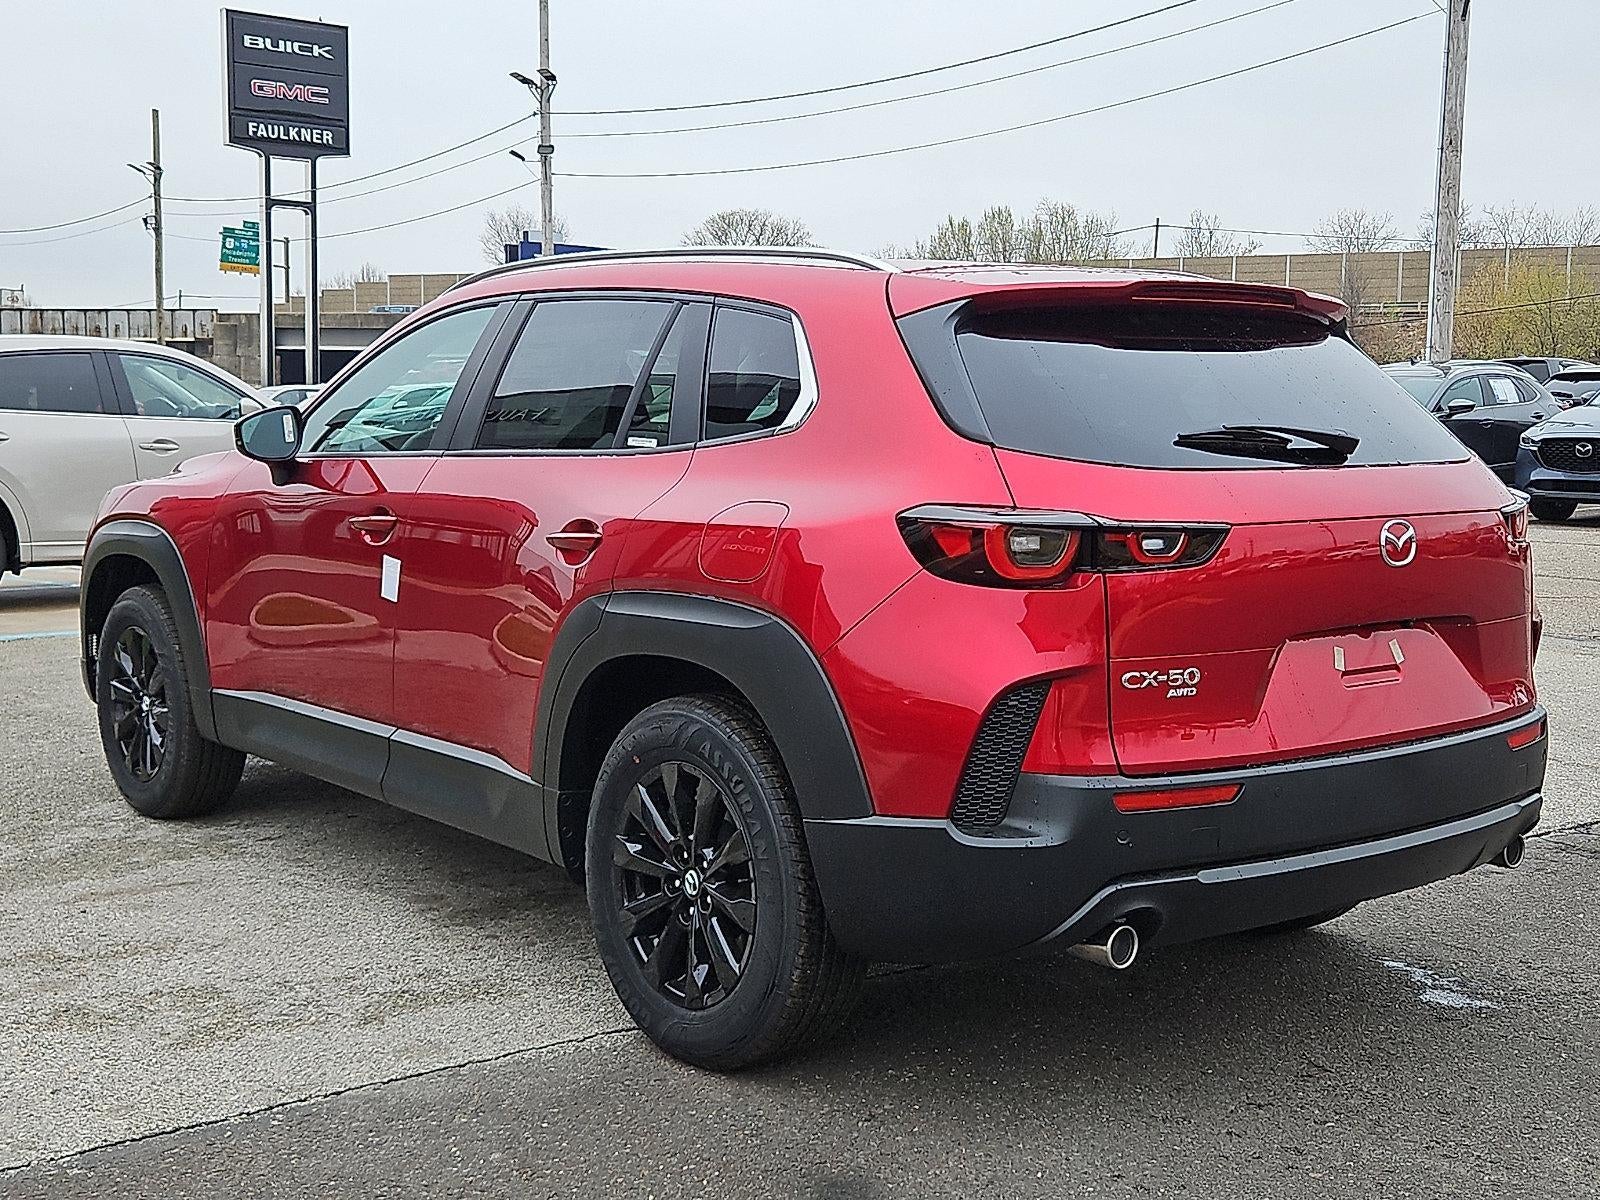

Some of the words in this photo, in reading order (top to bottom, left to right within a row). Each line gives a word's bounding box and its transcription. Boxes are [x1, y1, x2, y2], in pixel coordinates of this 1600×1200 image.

[243, 34, 334, 59] BUICK
[250, 79, 330, 104] GMC
[248, 122, 333, 145] FAULKNER
[1121, 667, 1201, 689] CX-50
